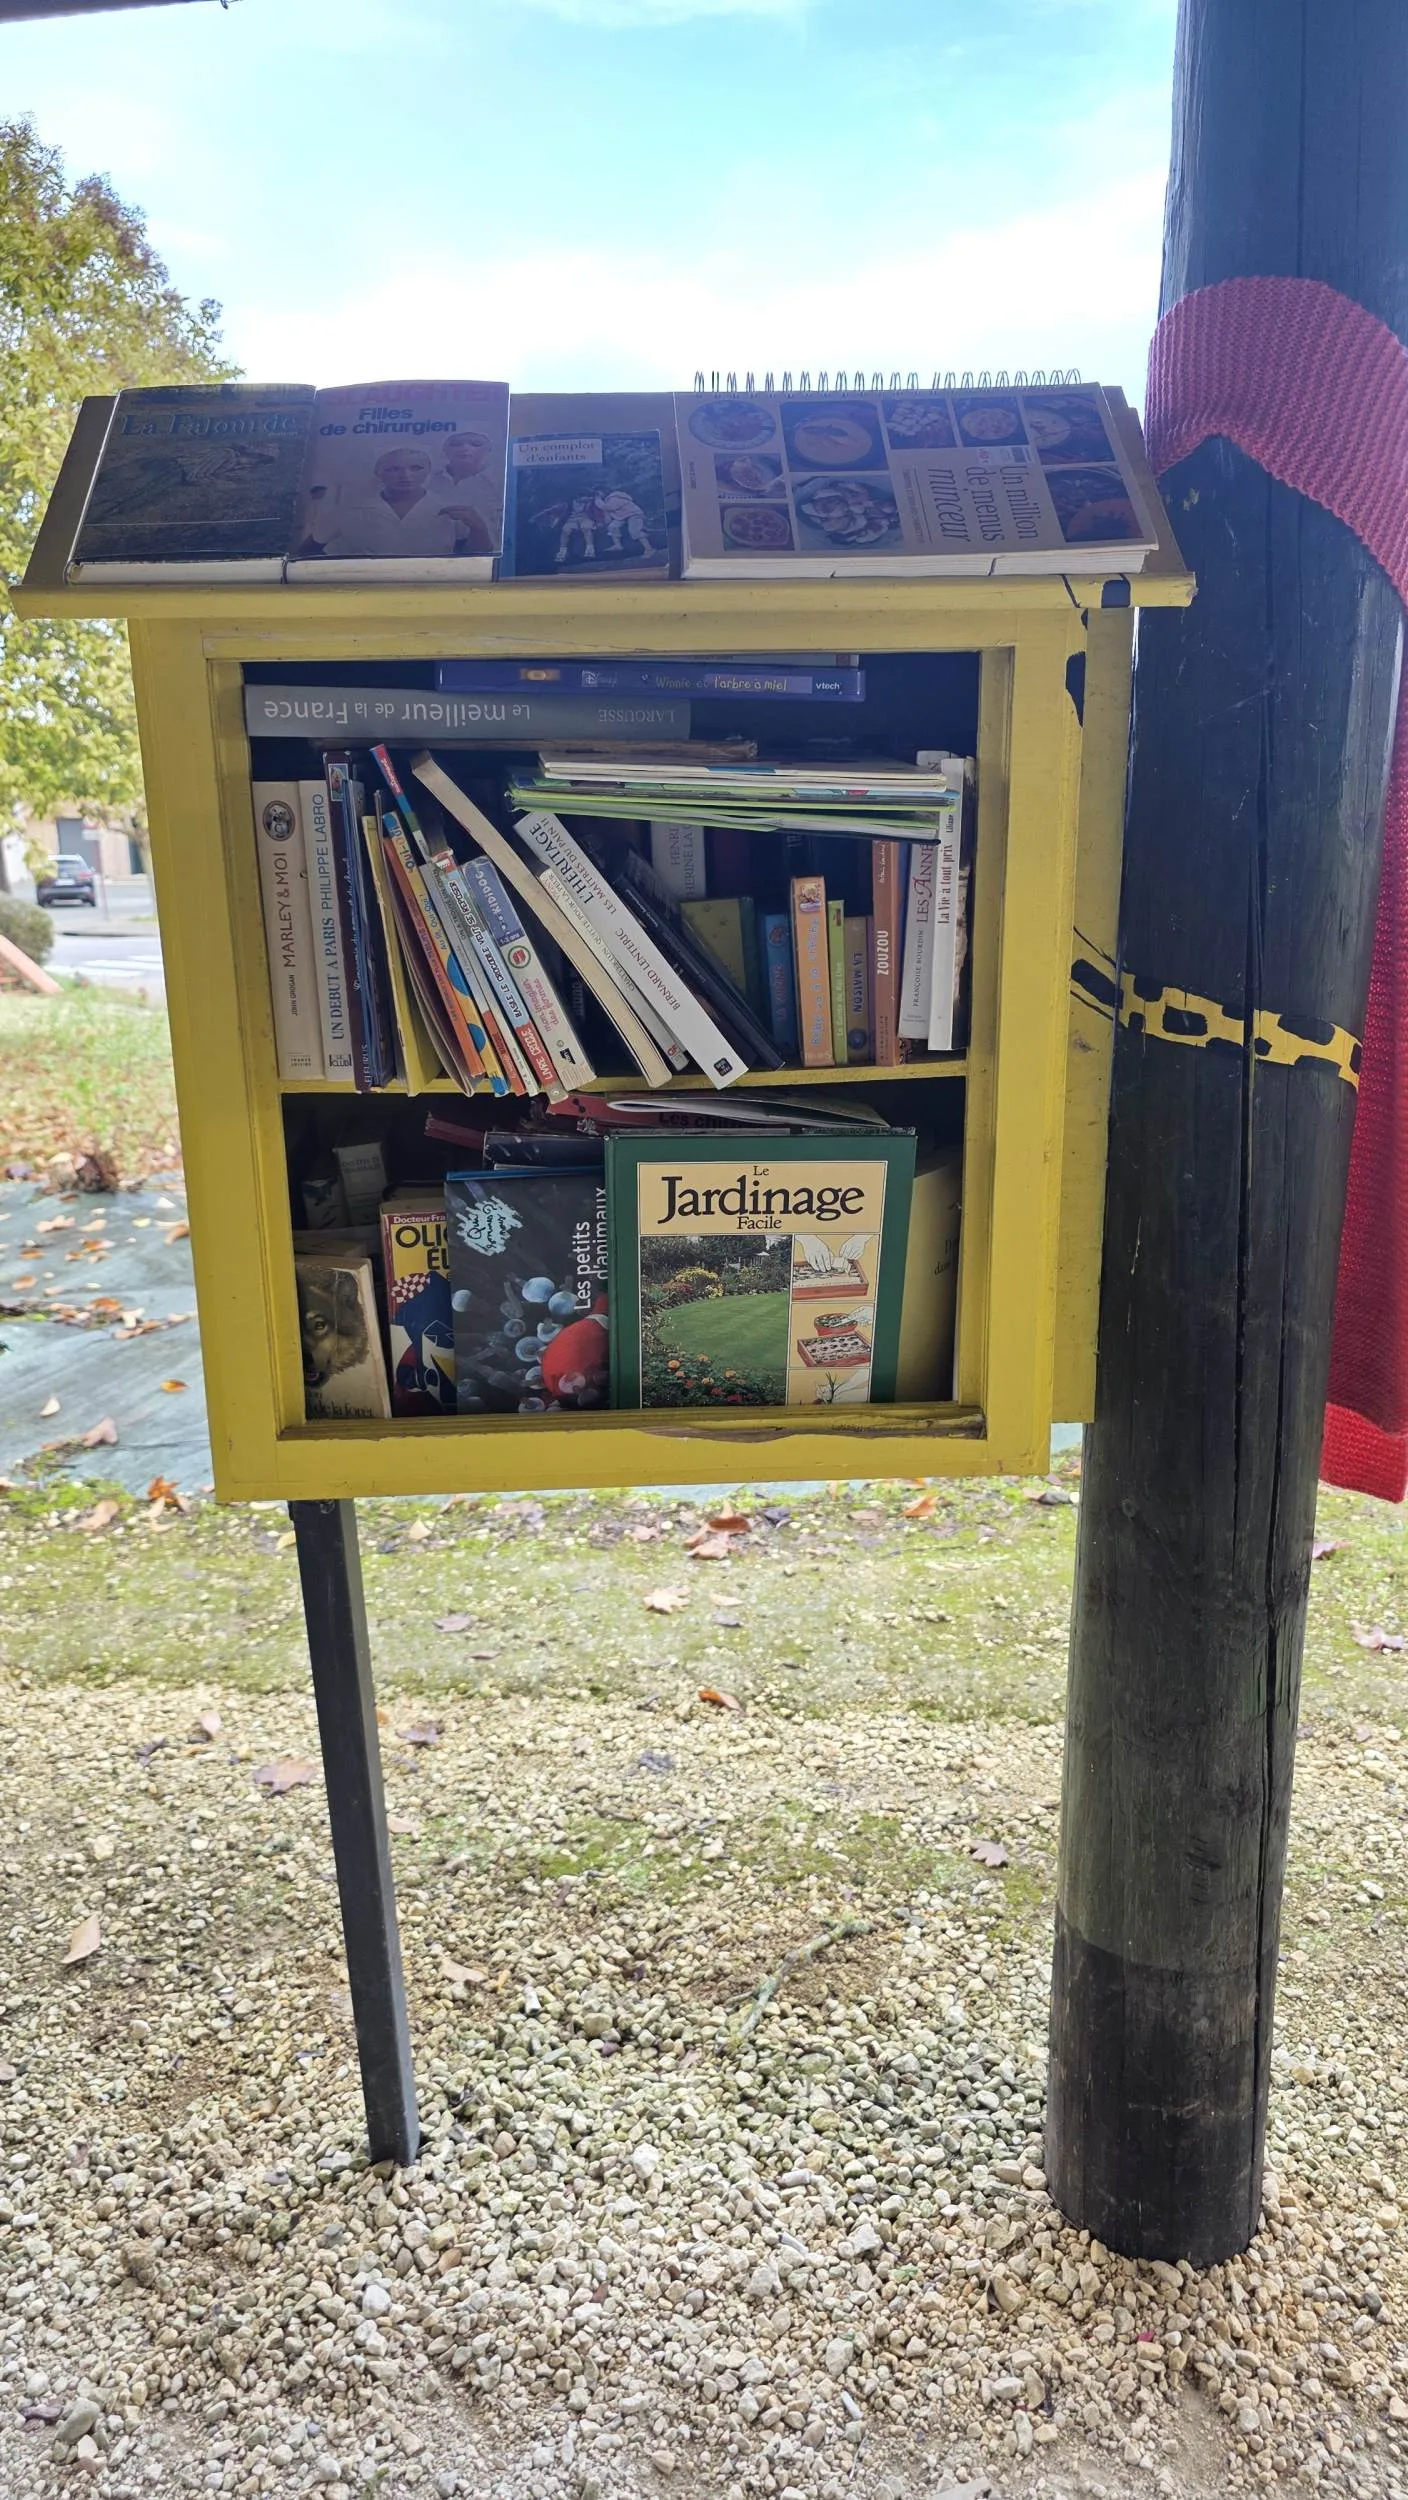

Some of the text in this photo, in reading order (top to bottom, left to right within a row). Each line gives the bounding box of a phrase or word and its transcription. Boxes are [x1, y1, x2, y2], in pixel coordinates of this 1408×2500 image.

[358, 407, 414, 421] Filles
[319, 419, 458, 437] de chirurgien
[518, 441, 595, 454] Un complot
[526, 452, 587, 463] d'enfants
[966, 466, 997, 486] de
[928, 468, 971, 542] minceur
[1000, 465, 1042, 540] Un million
[971, 489, 1005, 541] menus
[764, 678, 787, 692] miel
[815, 682, 841, 691] vtech
[263, 700, 532, 728] Le meilleur de la France
[598, 707, 677, 724] LAROUSSE
[547, 827, 566, 848] PAIN
[312, 793, 333, 910] PHILIPPE LABRO
[563, 848, 577, 862] DU
[940, 844, 955, 863] prix
[529, 822, 595, 904] L'HÉRITAGE
[576, 862, 606, 899] MAÎTRES
[940, 866, 952, 885] tout
[448, 880, 470, 914] REPOSER
[937, 897, 951, 910] Vie
[273, 852, 297, 968] MARLEY & MOI
[604, 899, 617, 916] LES
[916, 899, 930, 923] LES
[937, 913, 950, 924] La
[321, 917, 338, 957] PARIS
[614, 926, 651, 971] LENTERIC
[876, 929, 889, 976] ZOUZOU
[646, 968, 681, 1012] BERNARD
[853, 952, 863, 1013] LA MAISON
[290, 1000, 298, 1017] JOHN
[332, 1021, 345, 1040] UN
[535, 1055, 554, 1081] LIVRE
[753, 1165, 770, 1177] Le
[657, 1174, 865, 1225] Jardinage
[393, 1214, 447, 1224] Docteur Fra
[736, 1216, 782, 1230] Facile
[572, 1221, 597, 1310] Les petits
